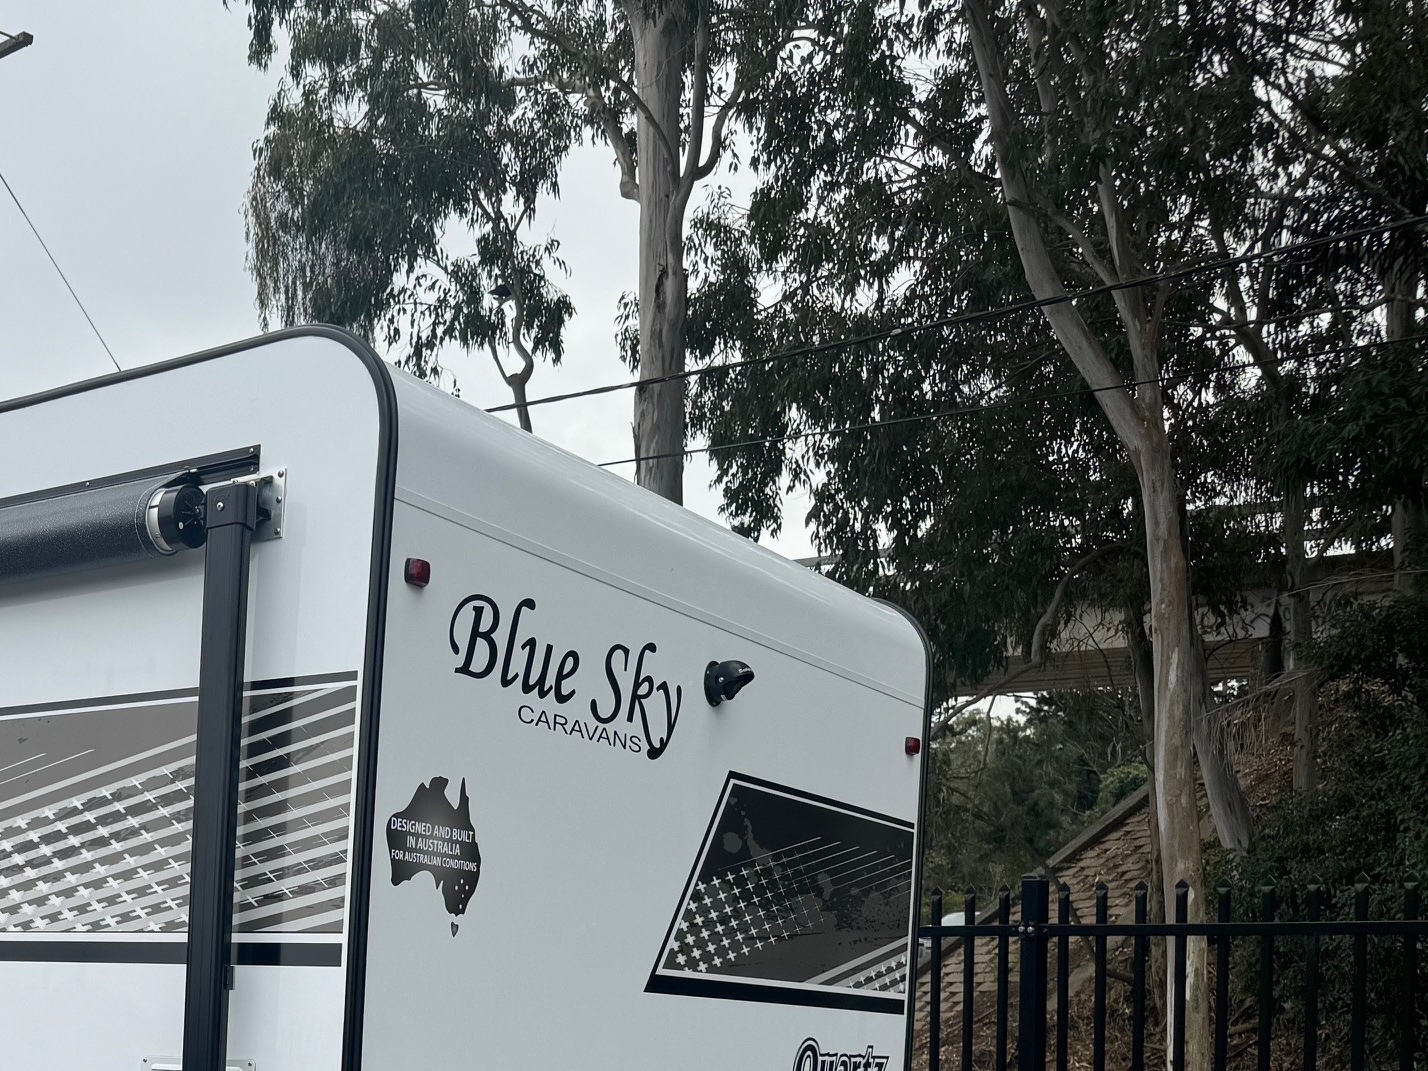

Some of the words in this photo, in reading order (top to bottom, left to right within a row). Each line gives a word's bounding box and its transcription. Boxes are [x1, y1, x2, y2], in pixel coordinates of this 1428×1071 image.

[449, 593, 580, 704] Blue
[590, 642, 682, 760] Sky
[517, 705, 642, 753] CARAVANS
[391, 817, 432, 836] DESIGNED
[433, 825, 451, 839] AND
[452, 828, 474, 843] BUILT
[407, 835, 416, 848] IN
[417, 838, 460, 856] AUSTRALIA
[391, 849, 404, 861] FOR
[404, 851, 441, 867] AUSTRALIAN
[442, 857, 477, 872] CONDITIONS
